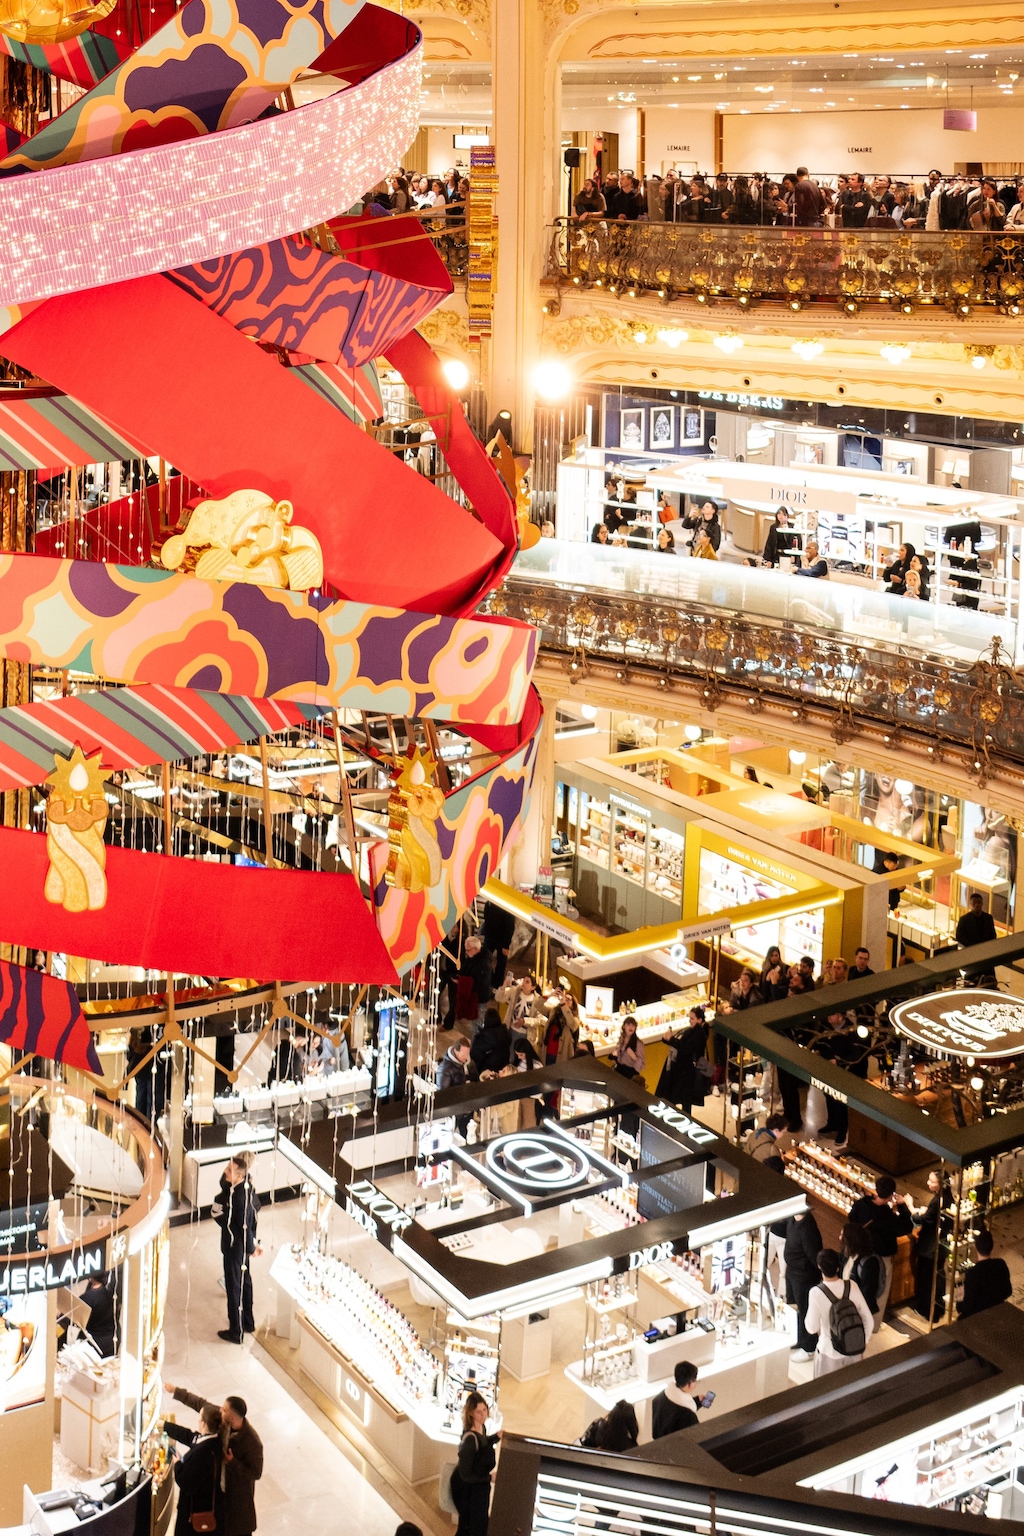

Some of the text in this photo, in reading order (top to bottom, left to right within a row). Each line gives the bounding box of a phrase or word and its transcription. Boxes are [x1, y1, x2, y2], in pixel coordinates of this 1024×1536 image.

[771, 487, 807, 505] DIOR
[684, 931, 700, 939] DRIES
[713, 924, 731, 933] NOTEN
[810, 1076, 848, 1105] DIPTYQUE
[648, 1100, 719, 1145] DIOR
[344, 1179, 413, 1232] DIOR
[345, 1196, 379, 1240] DIOR
[628, 1240, 676, 1271] DIOR
